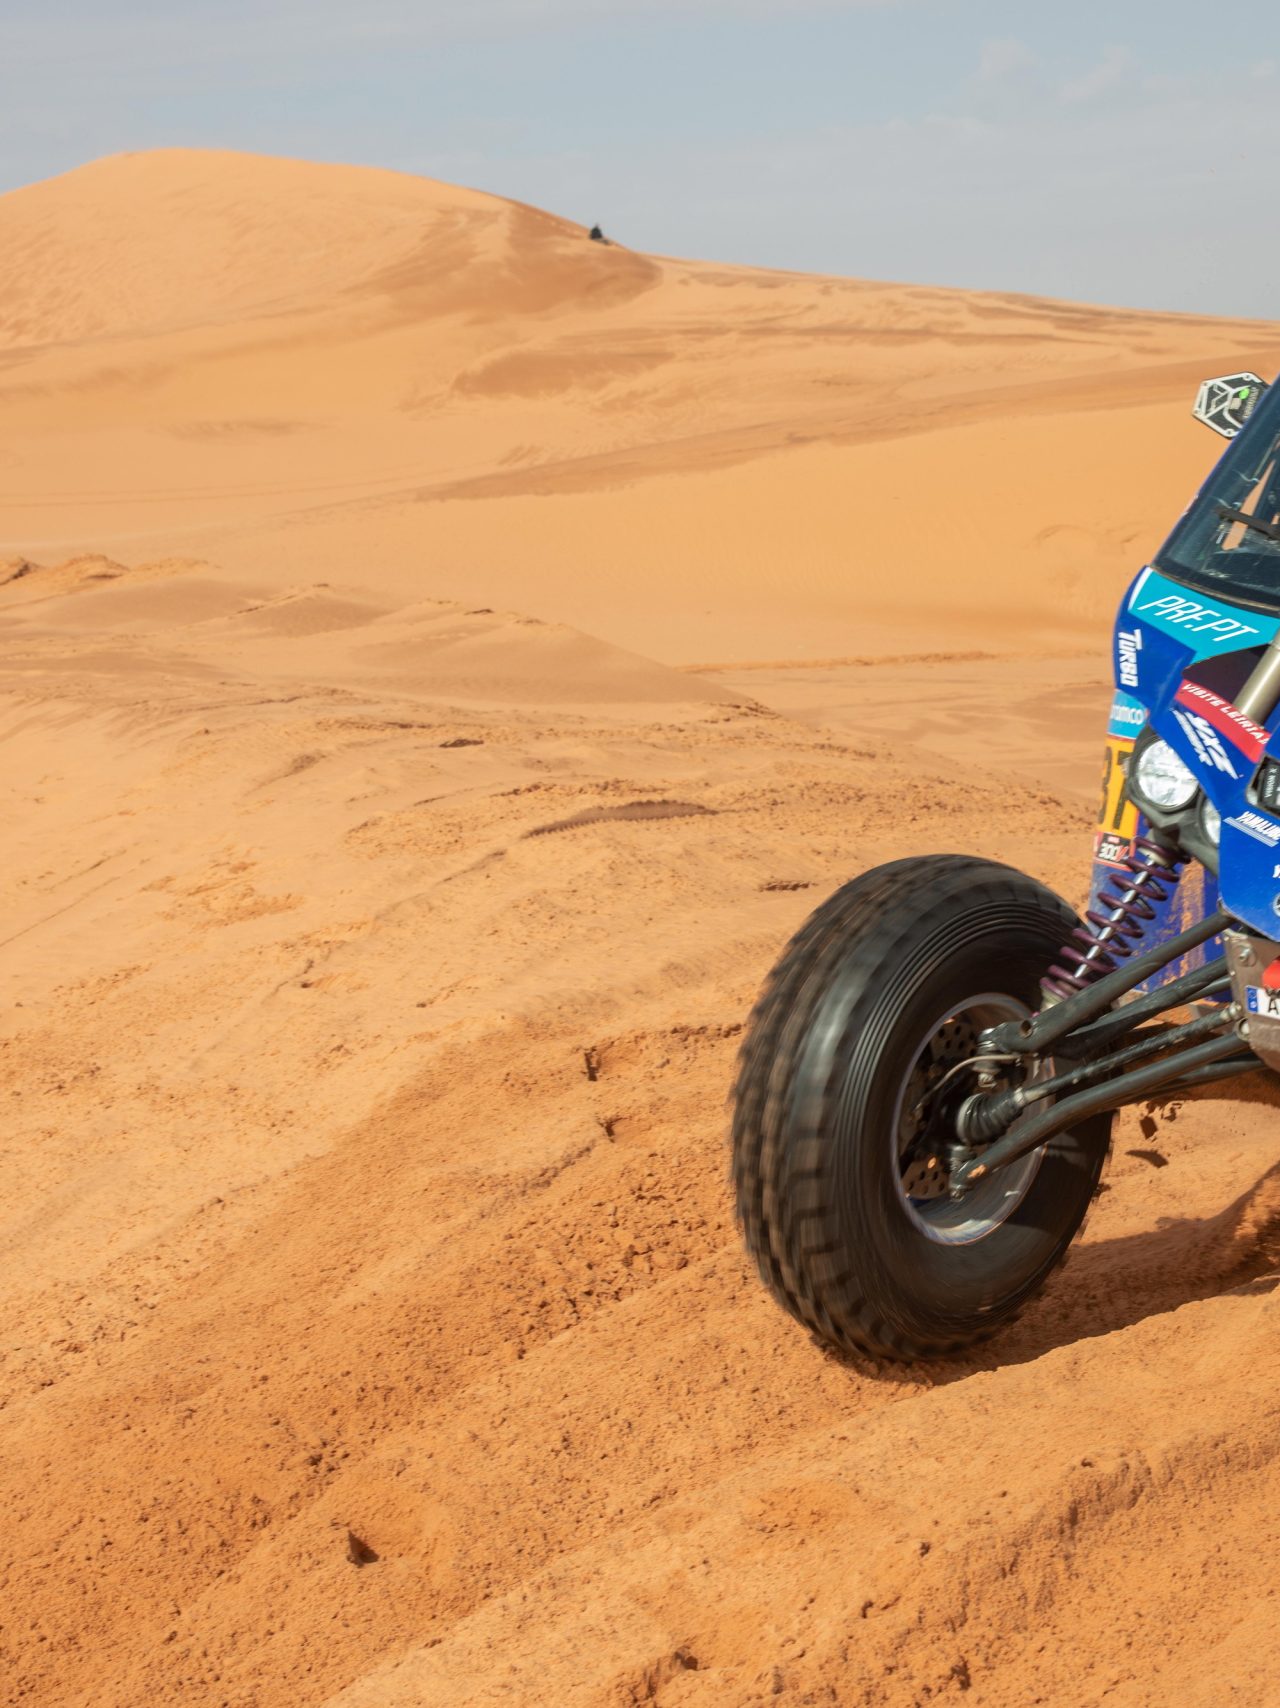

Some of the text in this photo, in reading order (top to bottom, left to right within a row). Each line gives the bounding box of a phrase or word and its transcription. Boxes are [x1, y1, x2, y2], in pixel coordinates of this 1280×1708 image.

[1137, 595, 1260, 642] PRF.PT
[1118, 629, 1142, 687] TURBO
[1182, 683, 1226, 706] VISITE
